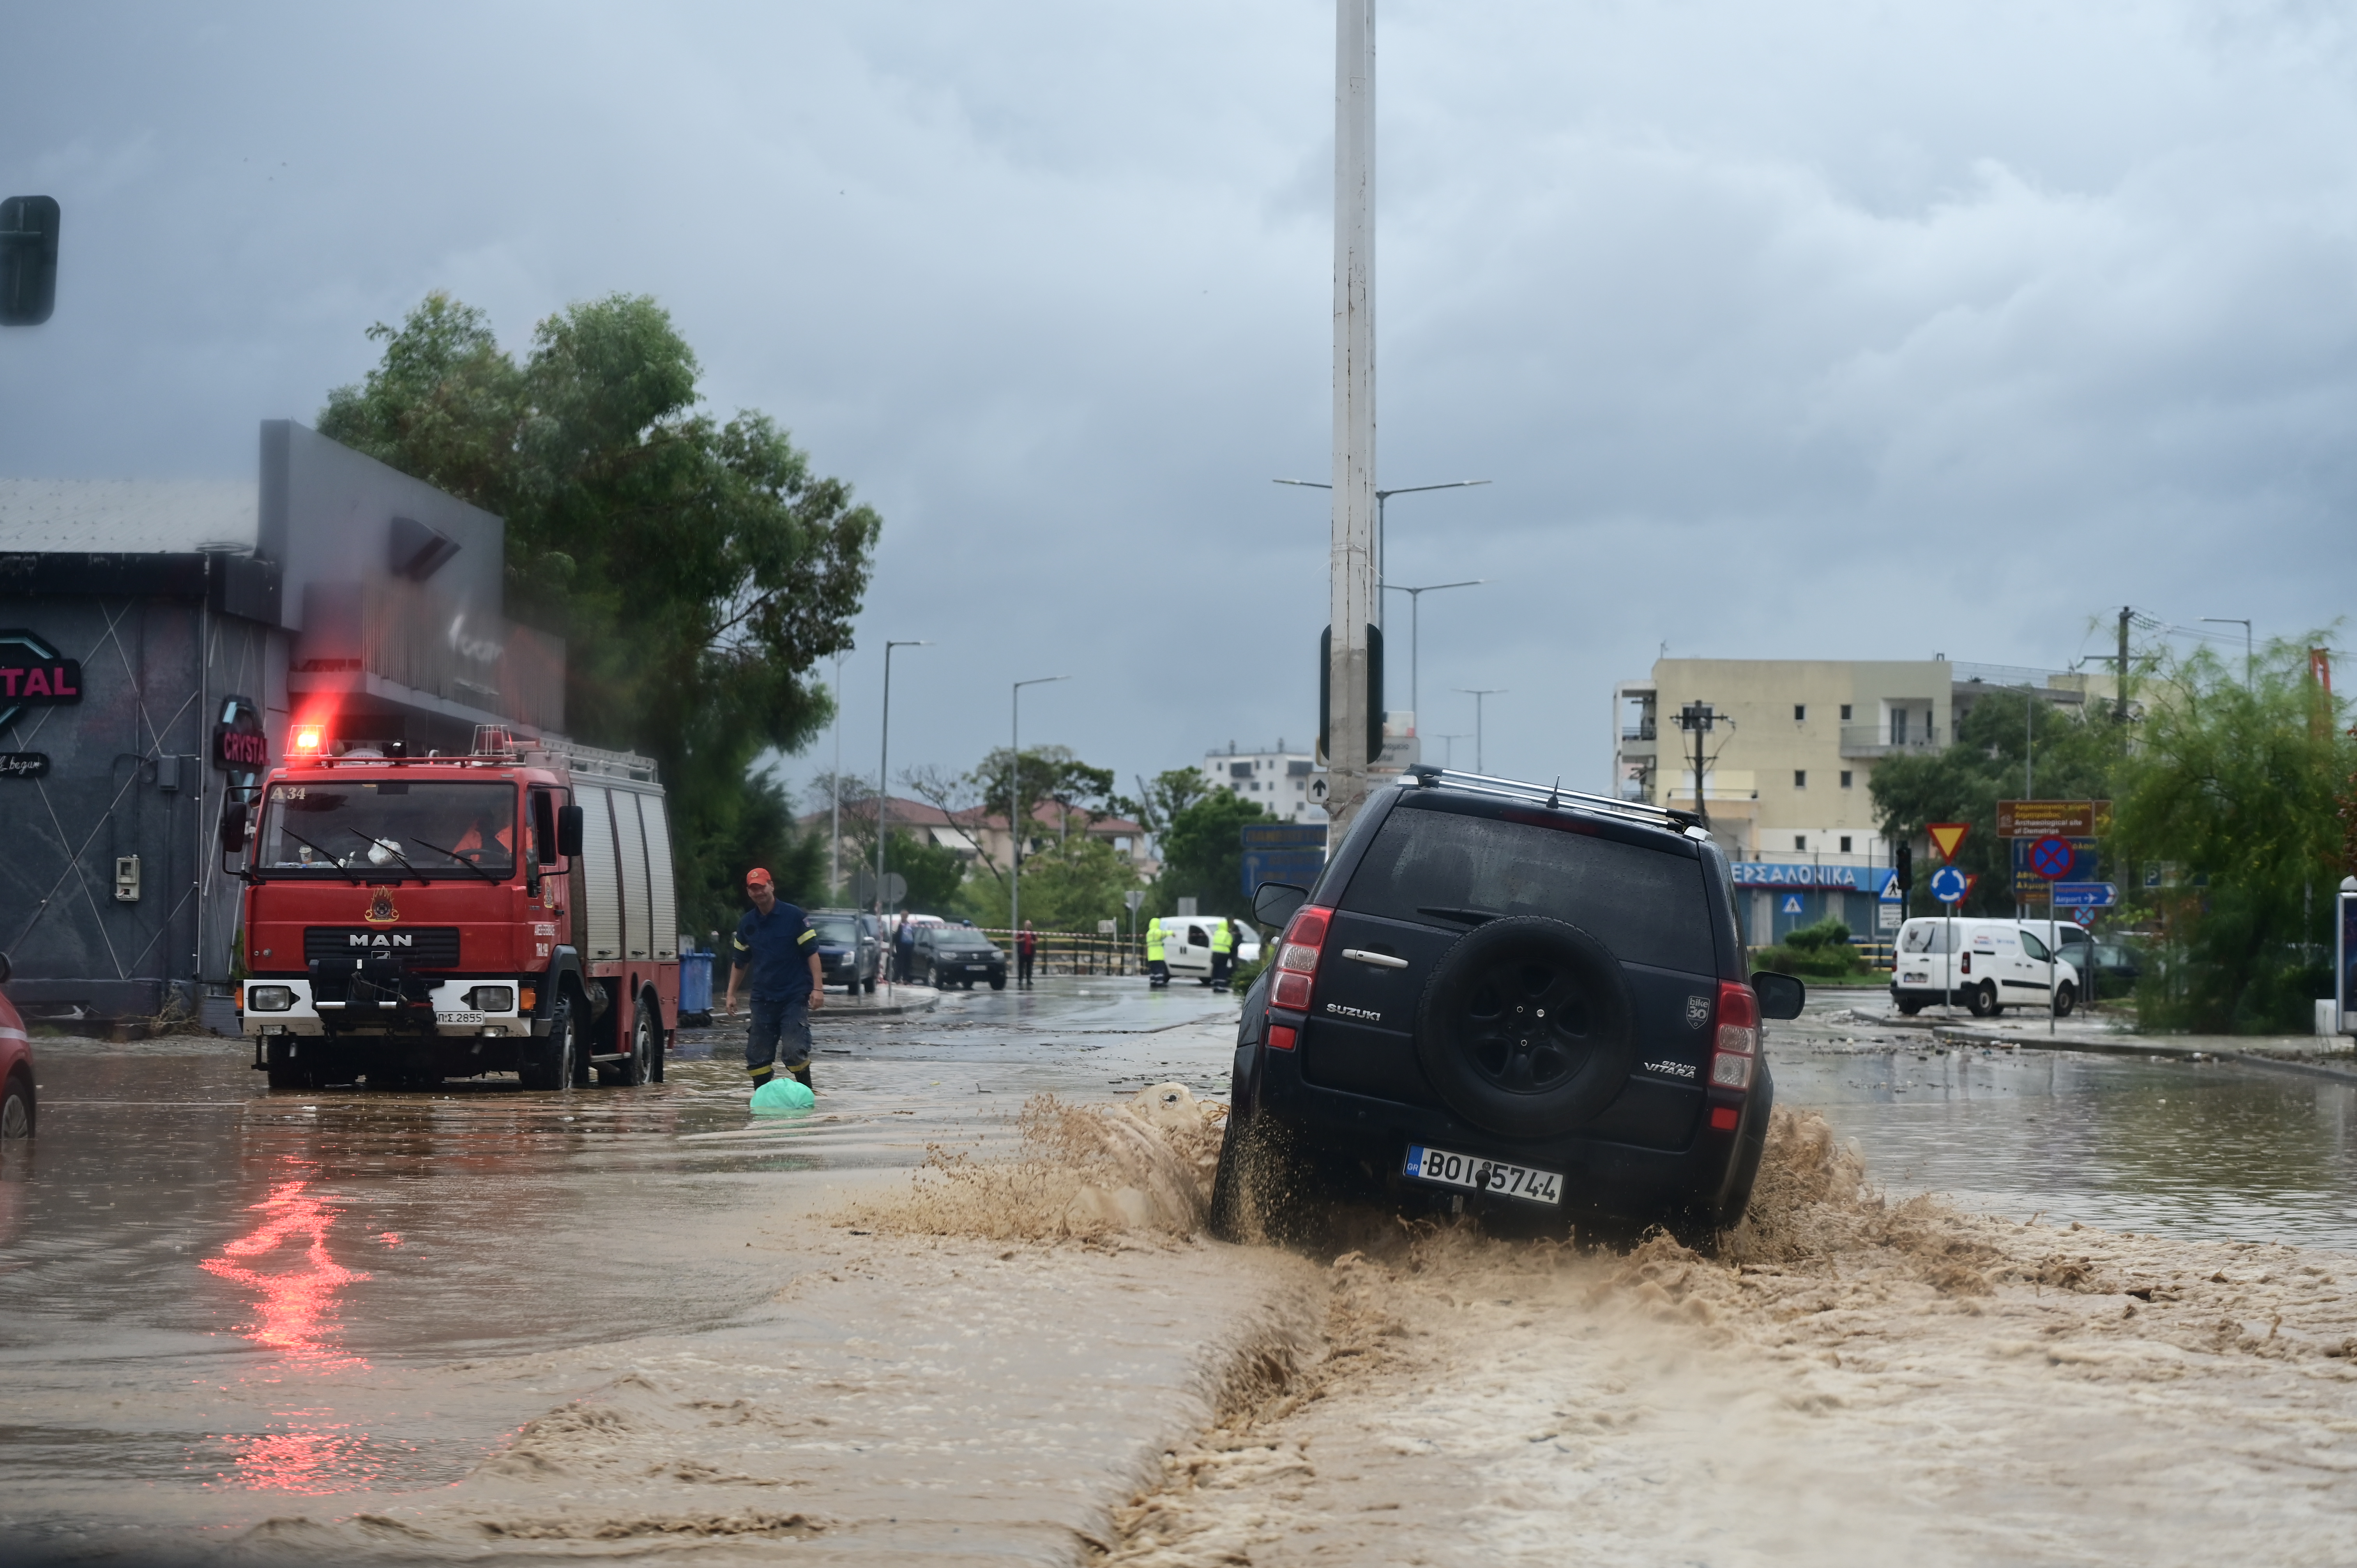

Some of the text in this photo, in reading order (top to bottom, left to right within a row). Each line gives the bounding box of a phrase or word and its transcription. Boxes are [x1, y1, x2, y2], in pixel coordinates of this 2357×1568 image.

[224, 733, 270, 766] CRYSTAL
[9, 756, 41, 775] began
[270, 787, 306, 800] A 34
[2056, 895, 2081, 904] Airport
[350, 935, 412, 946] MAN
[1689, 998, 1709, 1008] bike
[1326, 1003, 1381, 1021] SUZUKI
[1687, 1006, 1707, 1019] 30
[1644, 1062, 1694, 1079] VITARA
[1662, 1061, 1696, 1071] GRAND
[1407, 1162, 1419, 1172] GR
